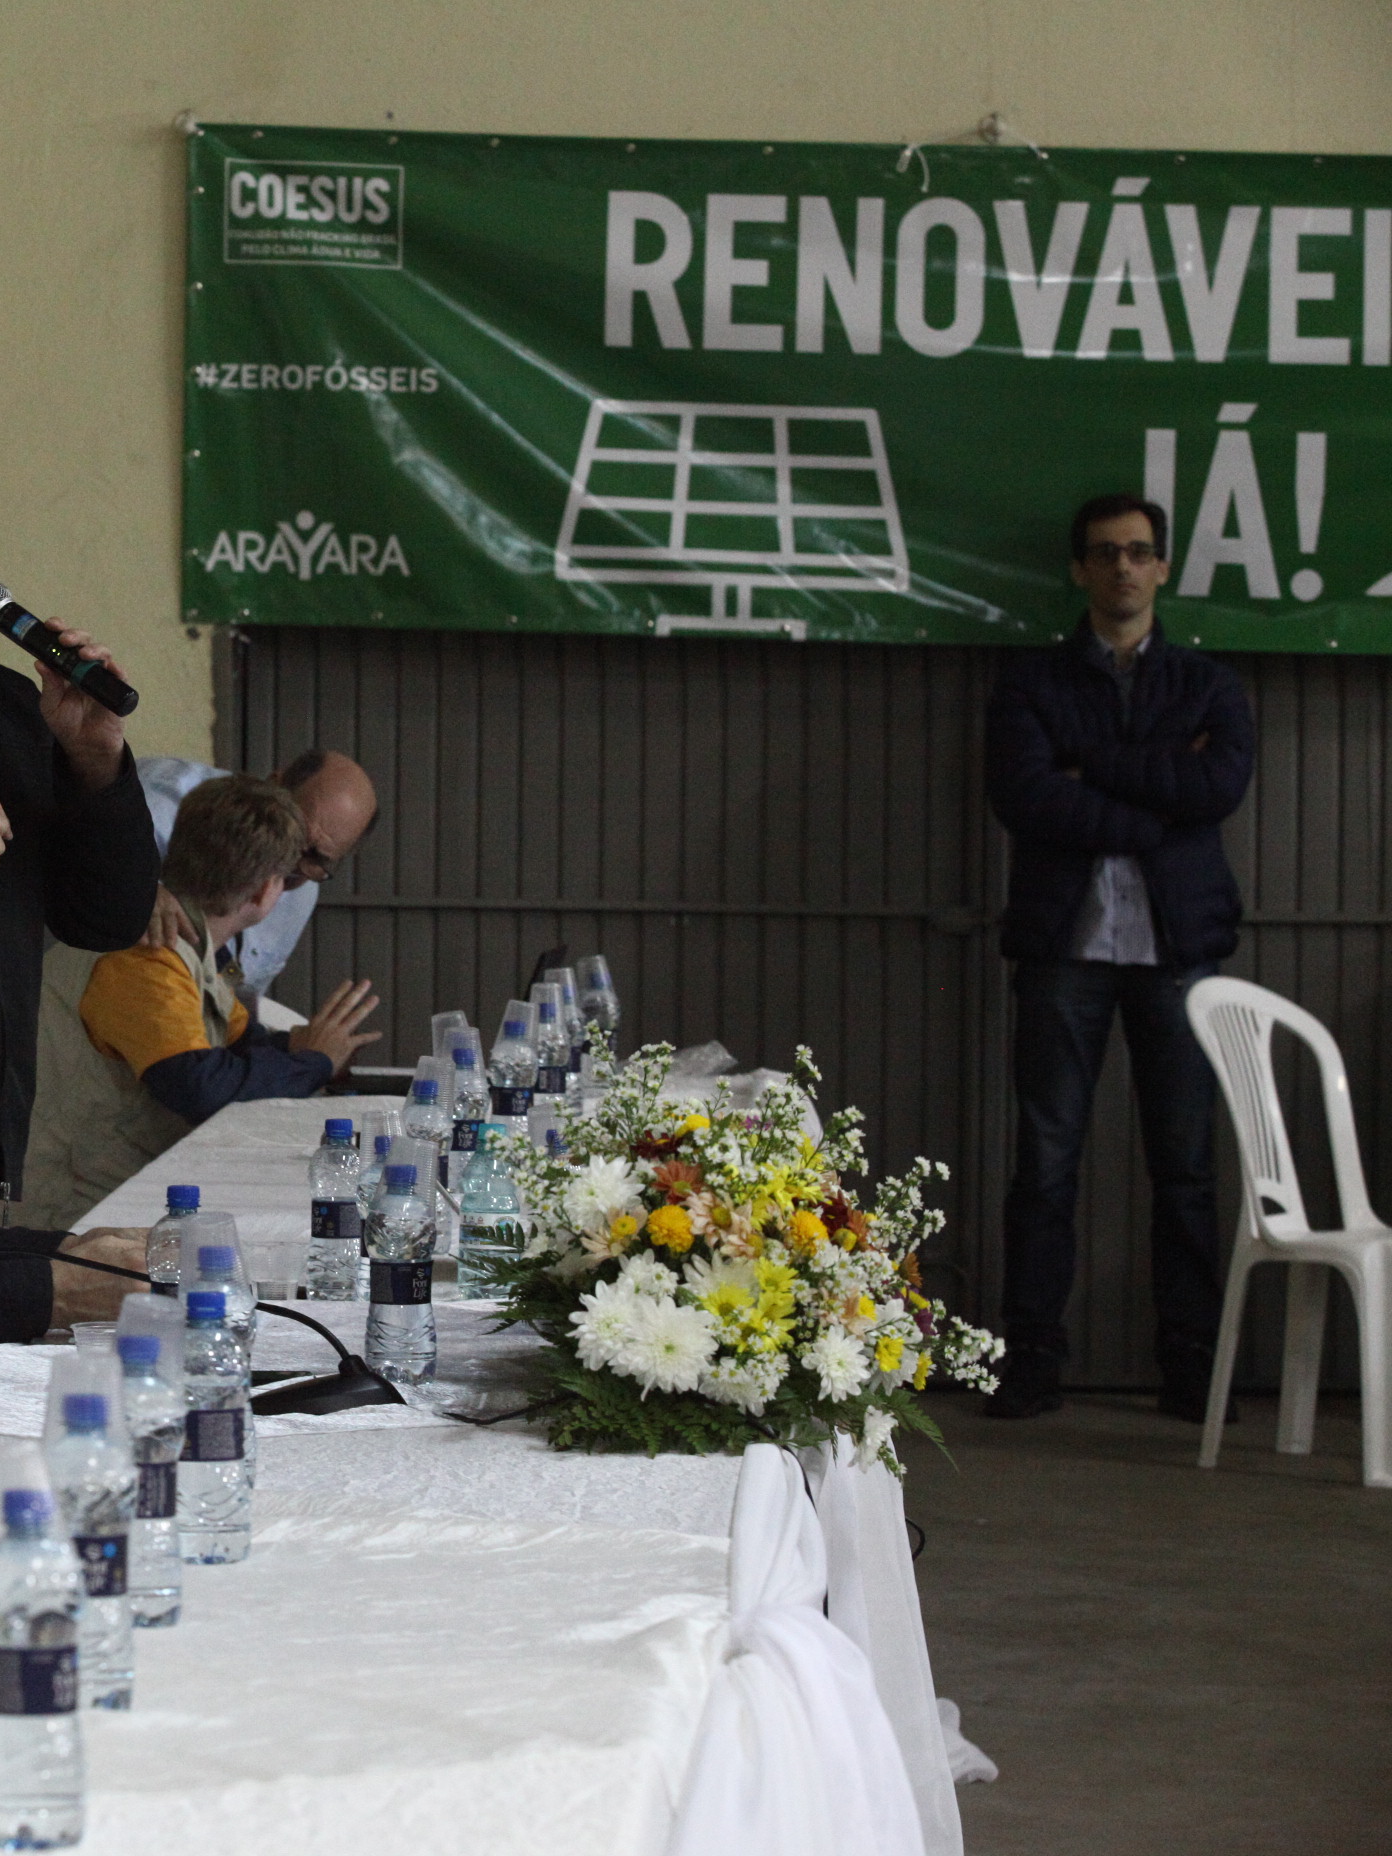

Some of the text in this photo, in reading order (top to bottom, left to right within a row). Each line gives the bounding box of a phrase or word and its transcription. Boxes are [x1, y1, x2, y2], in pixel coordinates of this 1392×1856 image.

[230, 171, 391, 223] COESUS
[604, 177, 1392, 366] RENOVÁVEI
[195, 359, 439, 393] #ZEROFÓSSEIS
[205, 511, 411, 581] ARAYARA
